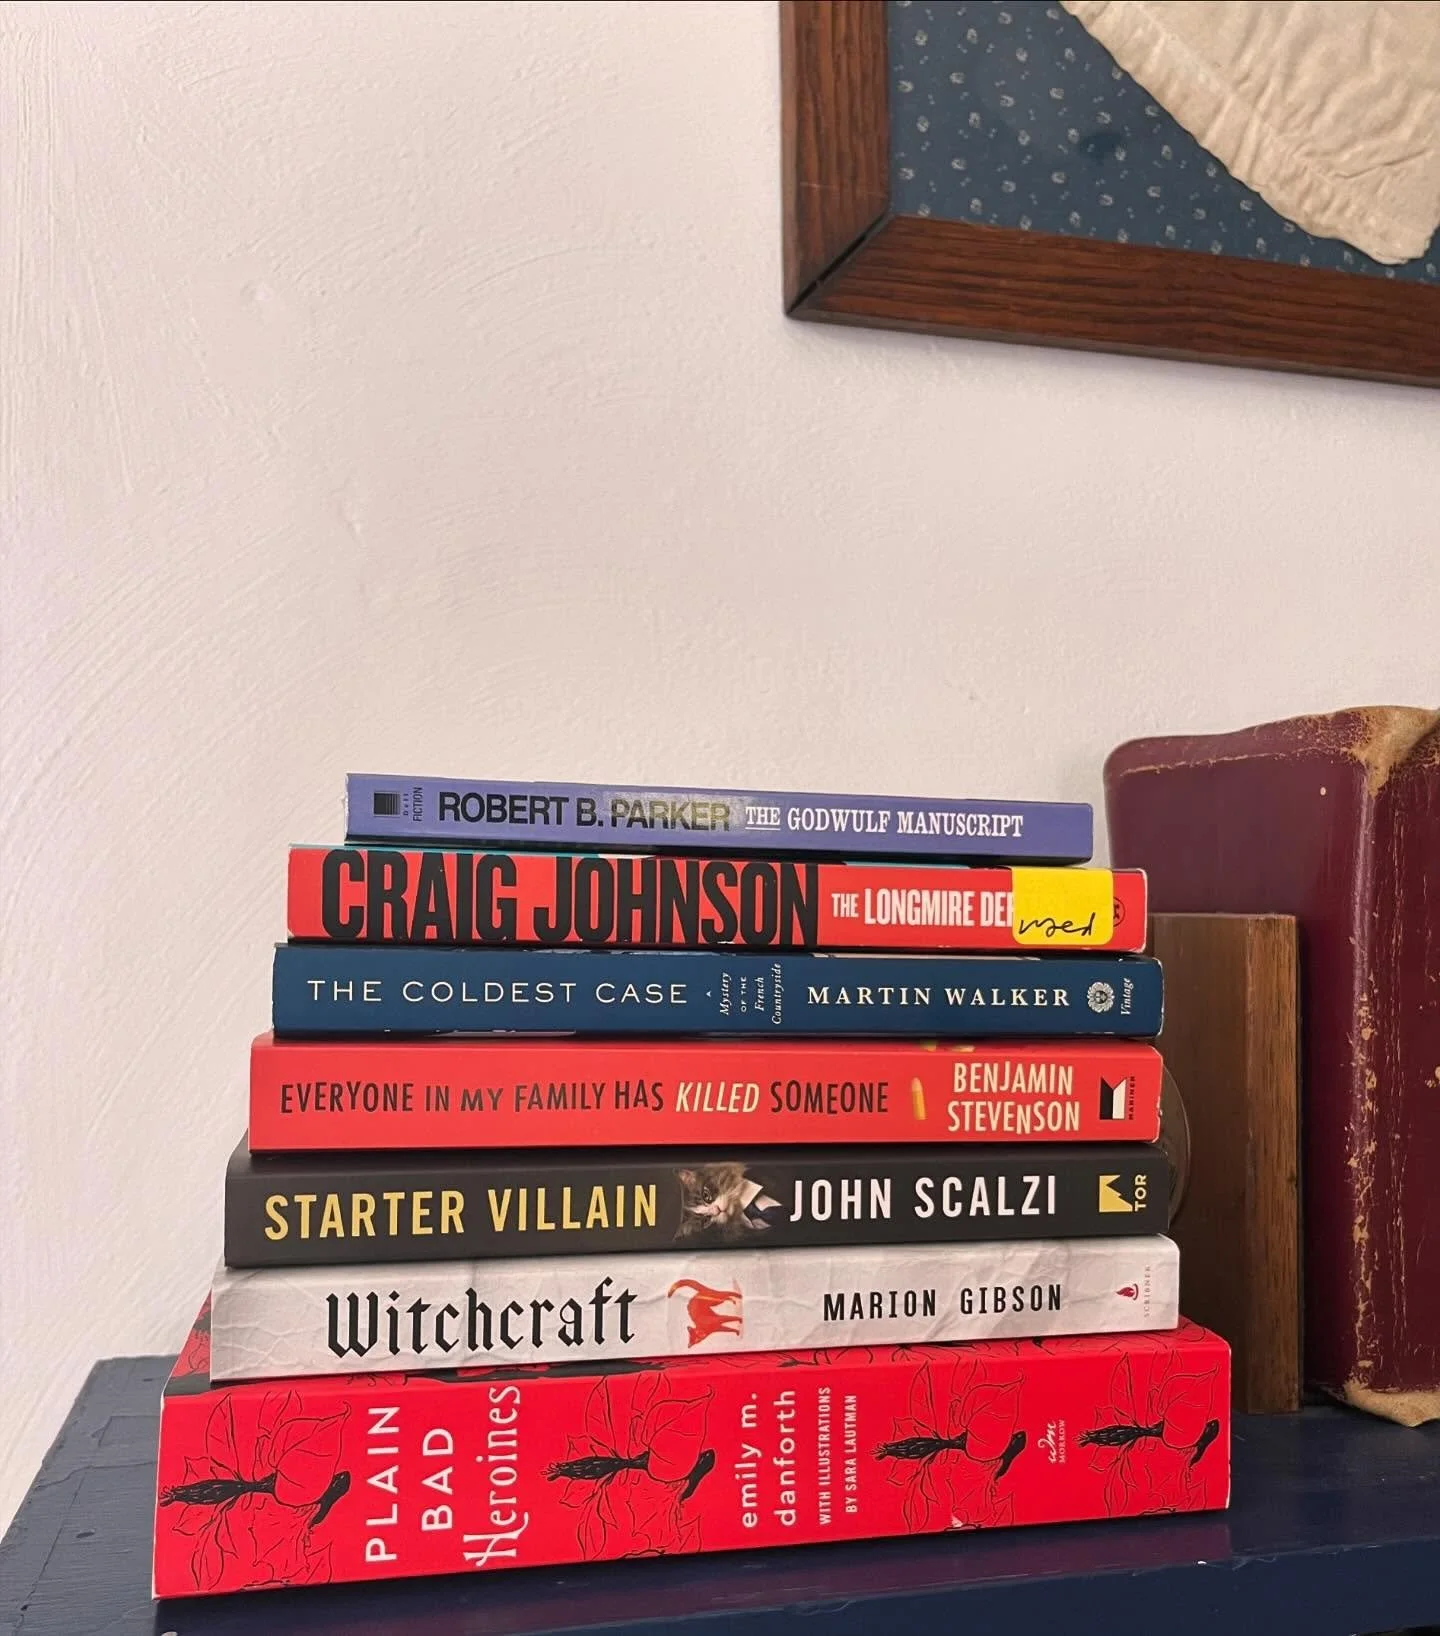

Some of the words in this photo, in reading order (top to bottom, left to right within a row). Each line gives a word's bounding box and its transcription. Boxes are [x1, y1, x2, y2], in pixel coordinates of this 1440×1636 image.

[412, 786, 424, 822] FICTION
[439, 791, 569, 825] ROBERT
[576, 795, 604, 828] B.
[611, 799, 731, 832] PARKER
[745, 806, 782, 827] THE
[787, 809, 891, 834] GODWULF
[897, 810, 1025, 838] MANUSCRIPT
[321, 849, 518, 943] CRAIG
[533, 856, 819, 947] JOHNSON
[831, 892, 859, 919] THE
[864, 888, 975, 928] LONGMIRE
[307, 980, 382, 1002] THE
[402, 981, 577, 1003] COLDEST
[595, 983, 688, 1004] CASE
[719, 972, 732, 1016] Mystery
[740, 976, 748, 996] THE
[754, 977, 765, 1012] French
[771, 963, 785, 1025] Countryside
[807, 986, 931, 1006] MARTIN
[944, 987, 1070, 1007] WALKER
[1120, 977, 1134, 1015] Vintage
[740, 1001, 748, 1013] OF
[280, 1081, 414, 1115] EVERYONE
[425, 1085, 450, 1112] IN
[460, 1087, 504, 1112] MY
[514, 1081, 605, 1113] FAMILY
[614, 1079, 664, 1112] HAS
[675, 1080, 759, 1113] KILLED
[771, 1080, 889, 1115] SOMEONE
[953, 1061, 1073, 1096] BENJAMIN
[947, 1101, 1080, 1135] STEVENSON
[264, 1190, 465, 1241] STARTER
[487, 1184, 657, 1232] VILLAIN
[789, 1178, 891, 1222] JOHN
[914, 1175, 1056, 1218] SCALZI
[1134, 1174, 1147, 1212] TOR
[823, 1289, 937, 1321] MARION
[960, 1284, 1061, 1315] GIBSON
[1143, 1266, 1151, 1318] SCRIBNER
[326, 1276, 638, 1358] Witchcraft
[741, 1393, 757, 1428] m.
[844, 1395, 857, 1453] LAUTMAN
[818, 1387, 831, 1486] ILLUSTRATIONS
[1058, 1419, 1066, 1463] MORROW
[463, 1386, 529, 1566] Heroines
[773, 1391, 796, 1526] danforth
[844, 1458, 857, 1491] SARA
[365, 1407, 400, 1562] PLAIN
[421, 1428, 454, 1531] BAD
[734, 1443, 762, 1527] emily
[818, 1491, 831, 1525] WITH
[845, 1497, 858, 1513] BY
